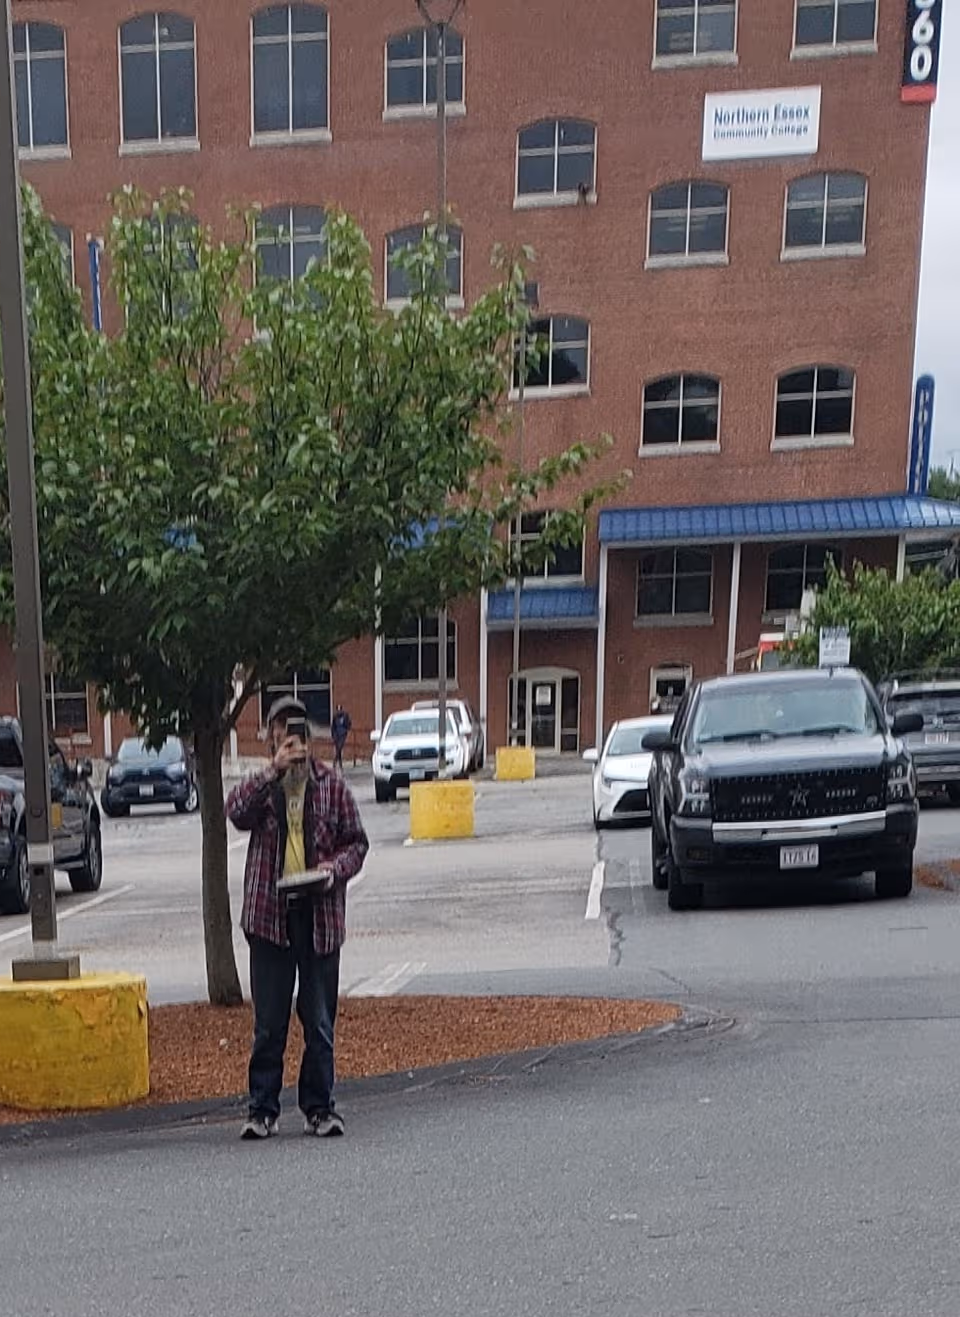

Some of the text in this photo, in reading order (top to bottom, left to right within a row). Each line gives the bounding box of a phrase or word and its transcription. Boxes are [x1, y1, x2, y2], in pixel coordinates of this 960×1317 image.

[910, 0, 935, 81] 60
[714, 102, 810, 126] Northern Essex
[713, 124, 808, 141] Community College
